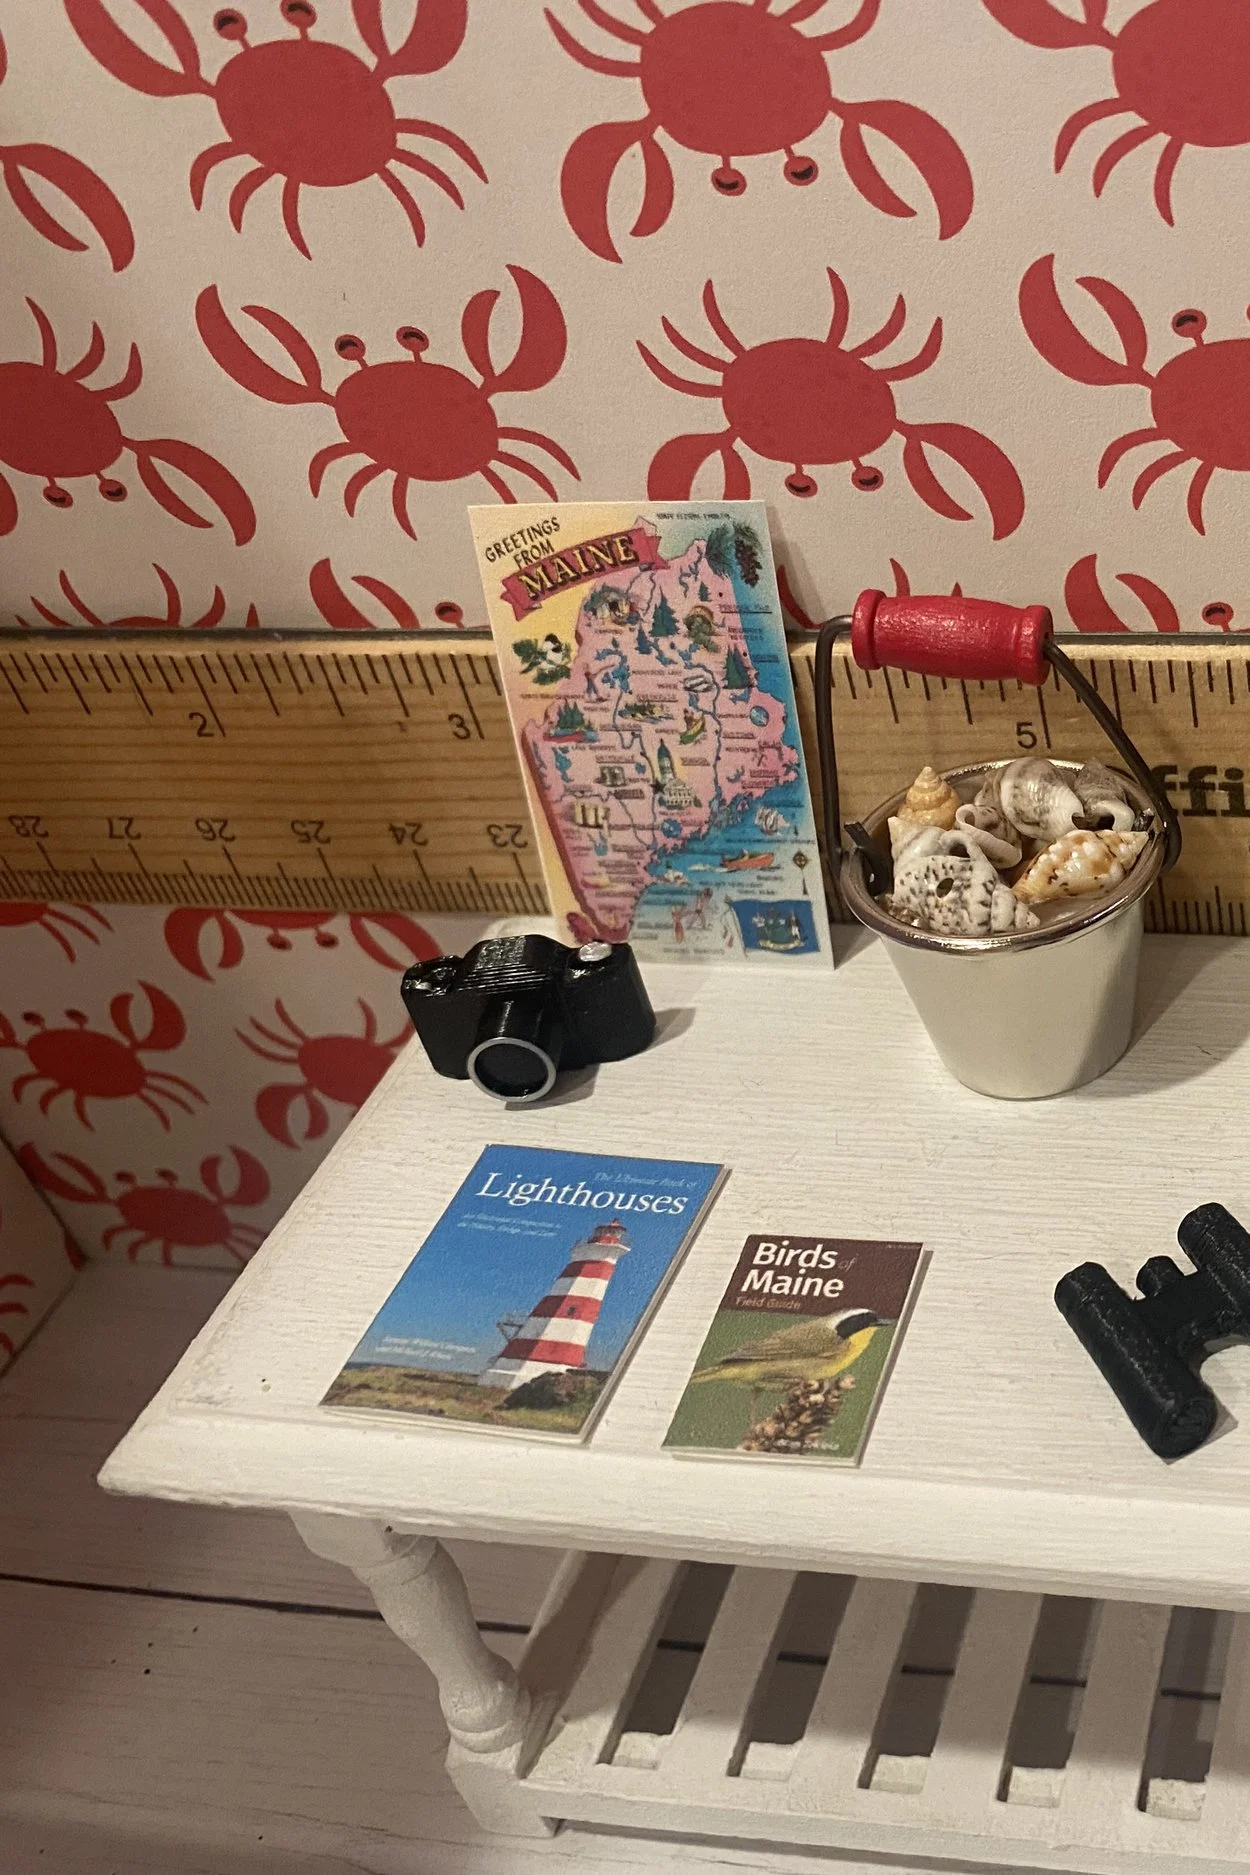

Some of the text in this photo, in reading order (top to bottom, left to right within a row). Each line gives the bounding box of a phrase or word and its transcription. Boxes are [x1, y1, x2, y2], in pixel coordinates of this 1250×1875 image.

[485, 516, 561, 563] GREETINGS
[513, 538, 555, 570] FROM
[518, 533, 640, 600] MAINE
[189, 711, 214, 738] 2
[448, 713, 471, 740] 3
[1017, 722, 1037, 749] 5
[7, 815, 49, 838] 28
[107, 817, 141, 840] 27
[195, 818, 236, 842] 26
[291, 820, 331, 843] 25
[389, 823, 427, 846] 24
[487, 825, 527, 848] 23
[475, 1172, 689, 1215] Lighthouses
[753, 1240, 838, 1269] Birds
[740, 1268, 844, 1298] Maine
[735, 1296, 765, 1308] Field
